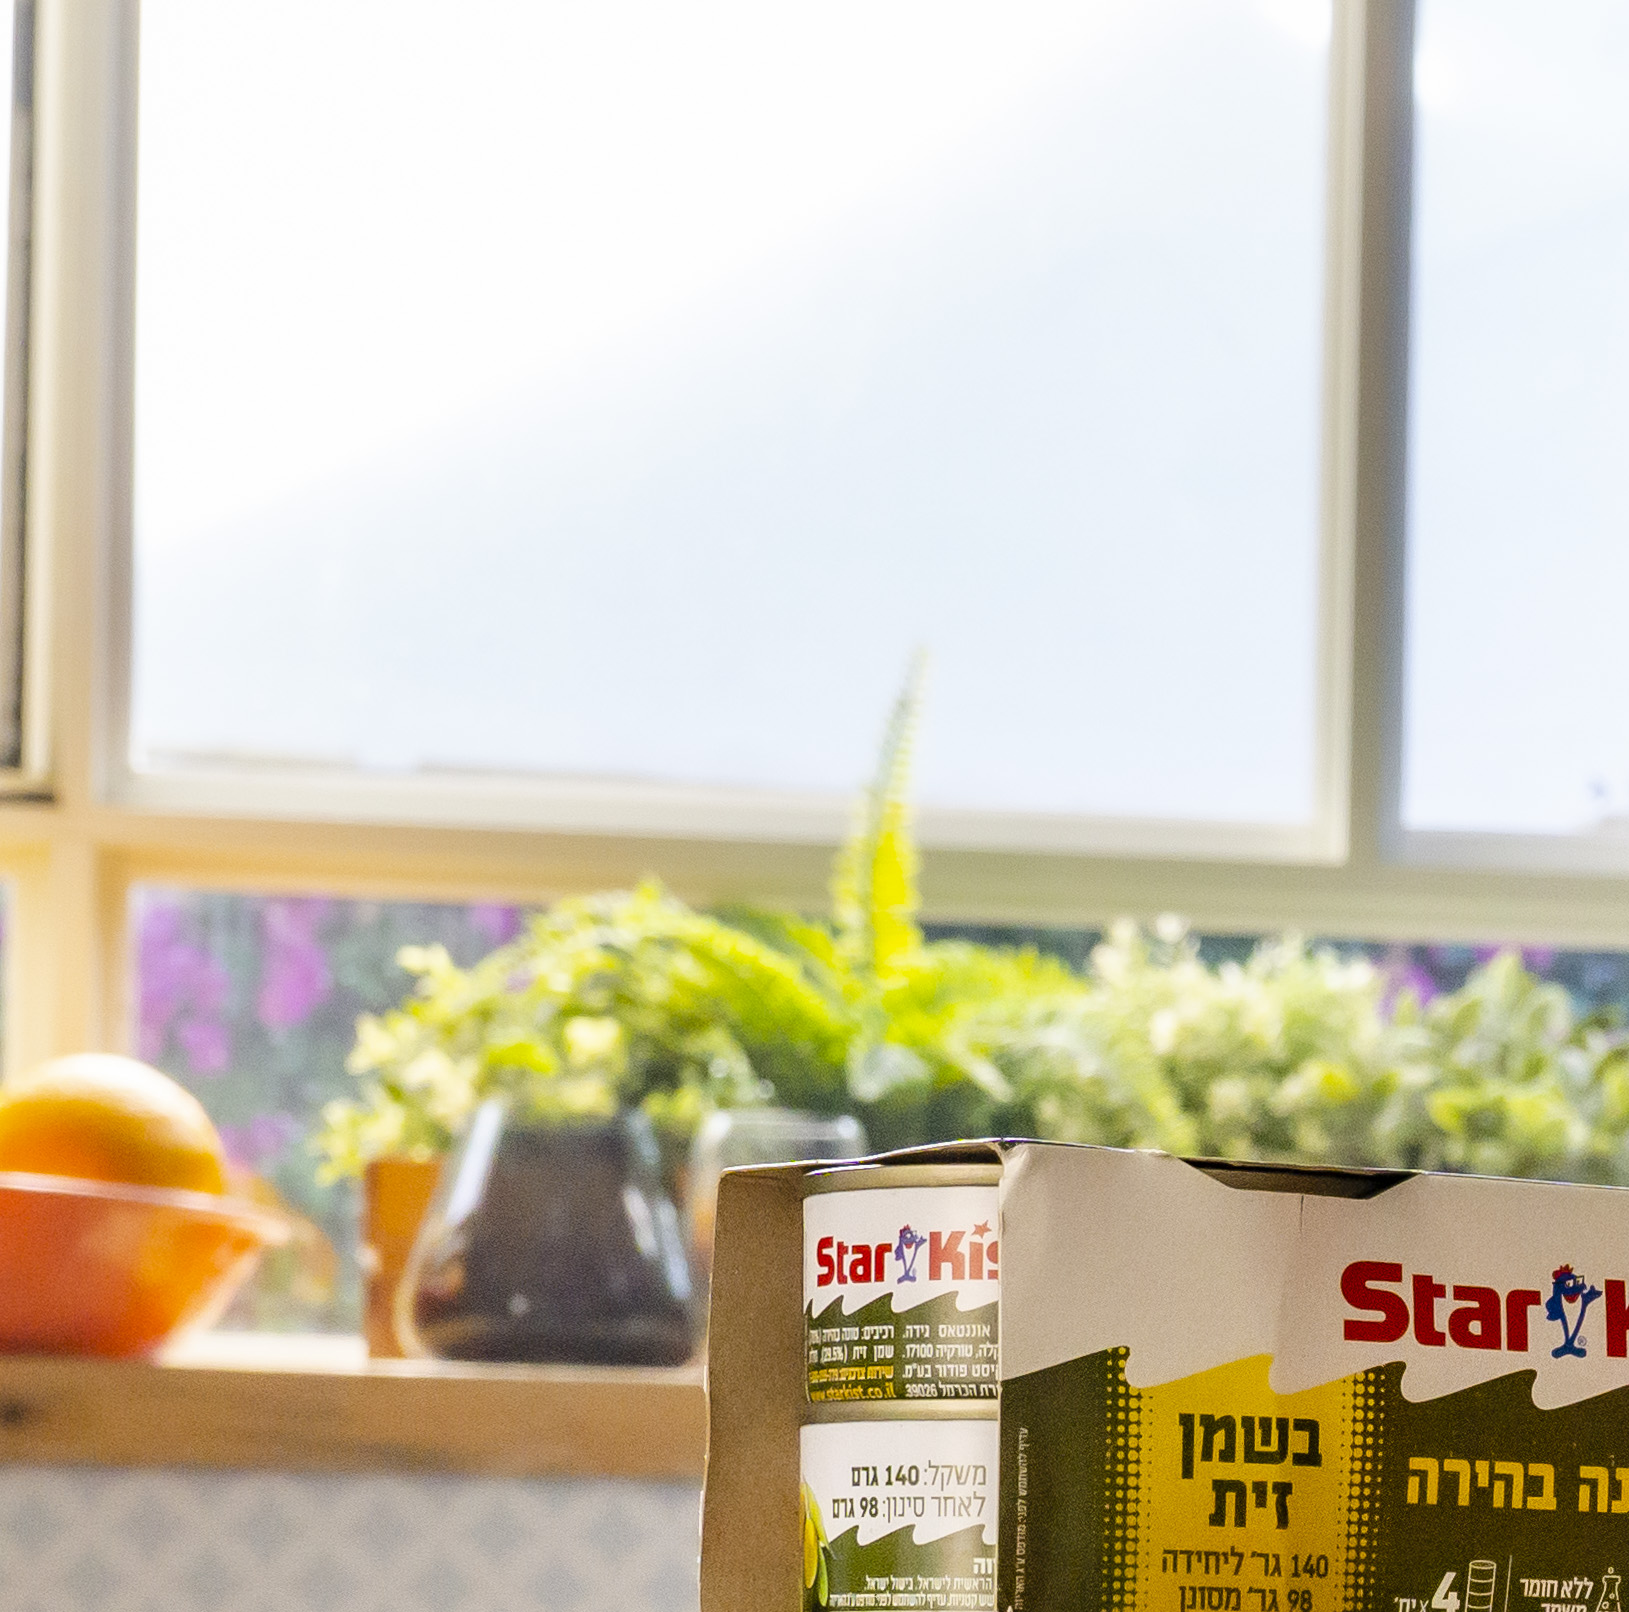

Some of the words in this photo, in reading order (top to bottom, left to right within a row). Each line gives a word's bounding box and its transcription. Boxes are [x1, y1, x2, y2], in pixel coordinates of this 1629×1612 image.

[1179, 1413, 1322, 1479] בשמן
[852, 1466, 878, 1486] גרם
[886, 1465, 919, 1486] 140
[923, 1460, 986, 1491] משקל:
[1406, 1455, 1557, 1511] בהירה
[833, 1498, 854, 1519] גרם
[860, 1497, 878, 1517] 98
[883, 1497, 925, 1523] סינון:
[931, 1492, 986, 1517] לאחר
[1209, 1479, 1293, 1530] זית
[1162, 1546, 1244, 1576] ליחידה
[1291, 1554, 1328, 1578] 140
[1519, 1578, 1559, 1598] חומר
[1561, 1577, 1594, 1599] ללא
